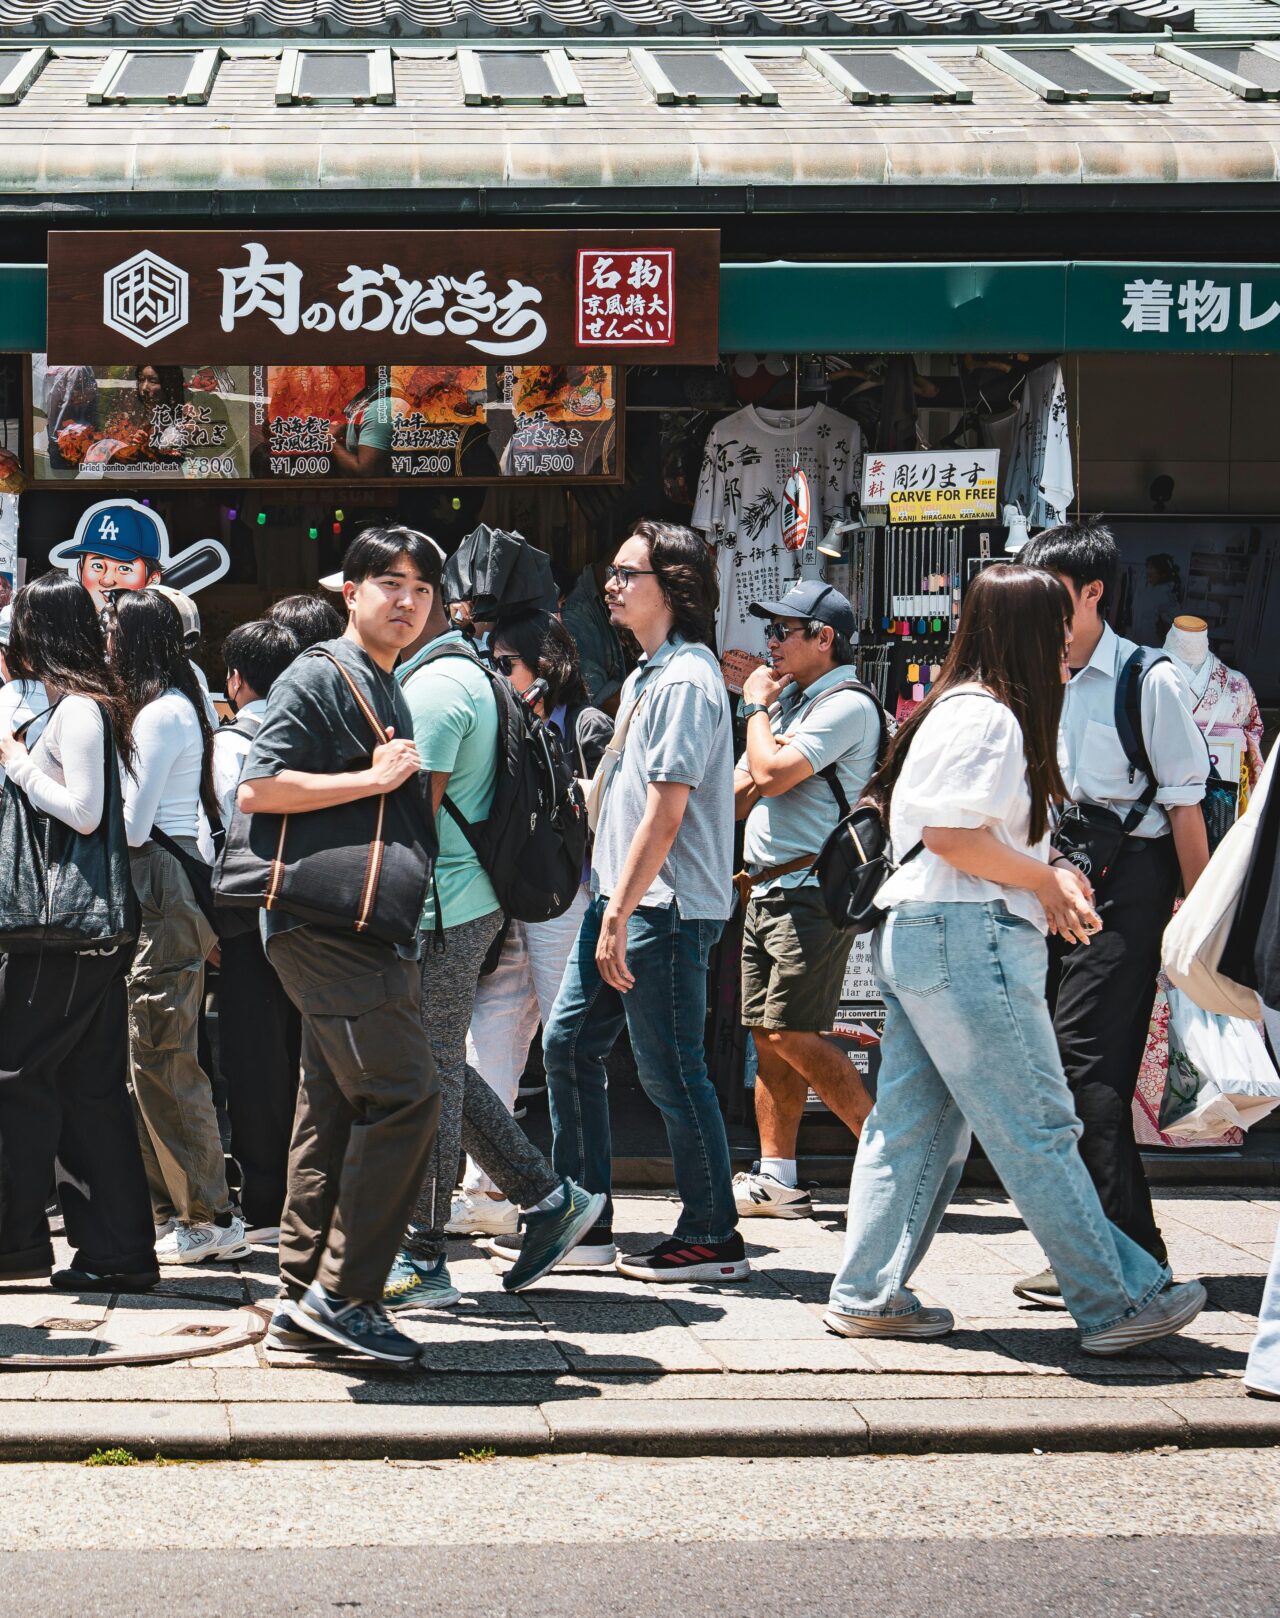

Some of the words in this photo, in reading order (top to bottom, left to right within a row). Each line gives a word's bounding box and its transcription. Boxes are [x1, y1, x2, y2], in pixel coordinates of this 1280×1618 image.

[586, 256, 663, 290] 名物
[217, 242, 548, 357] 肉のおだきち
[583, 293, 668, 316] 京風特大
[1120, 278, 1280, 333] 着物レ
[585, 317, 665, 338] せんべい
[271, 416, 331, 434] 赤海老と
[392, 411, 428, 430] 和牛
[514, 411, 549, 430] 和牛
[391, 430, 460, 448] お好み焼き
[513, 429, 584, 448] すき焼き
[79, 463, 100, 472] Dried
[102, 463, 126, 472] bonito
[127, 463, 141, 472] and
[142, 463, 161, 473] Kujo
[187, 457, 234, 474] ¥800
[271, 456, 330, 476] ¥1,000
[391, 456, 451, 475] ¥1,200
[514, 455, 575, 473] ¥1,500
[867, 460, 887, 498] 無料
[893, 462, 985, 490] 彫ります
[891, 490, 932, 503] CARVE
[936, 489, 961, 501] FOR
[966, 488, 996, 500] FREE
[921, 513, 956, 521] HIRAGANA
[98, 515, 119, 540] LA
[833, 1023, 861, 1036] nvert
